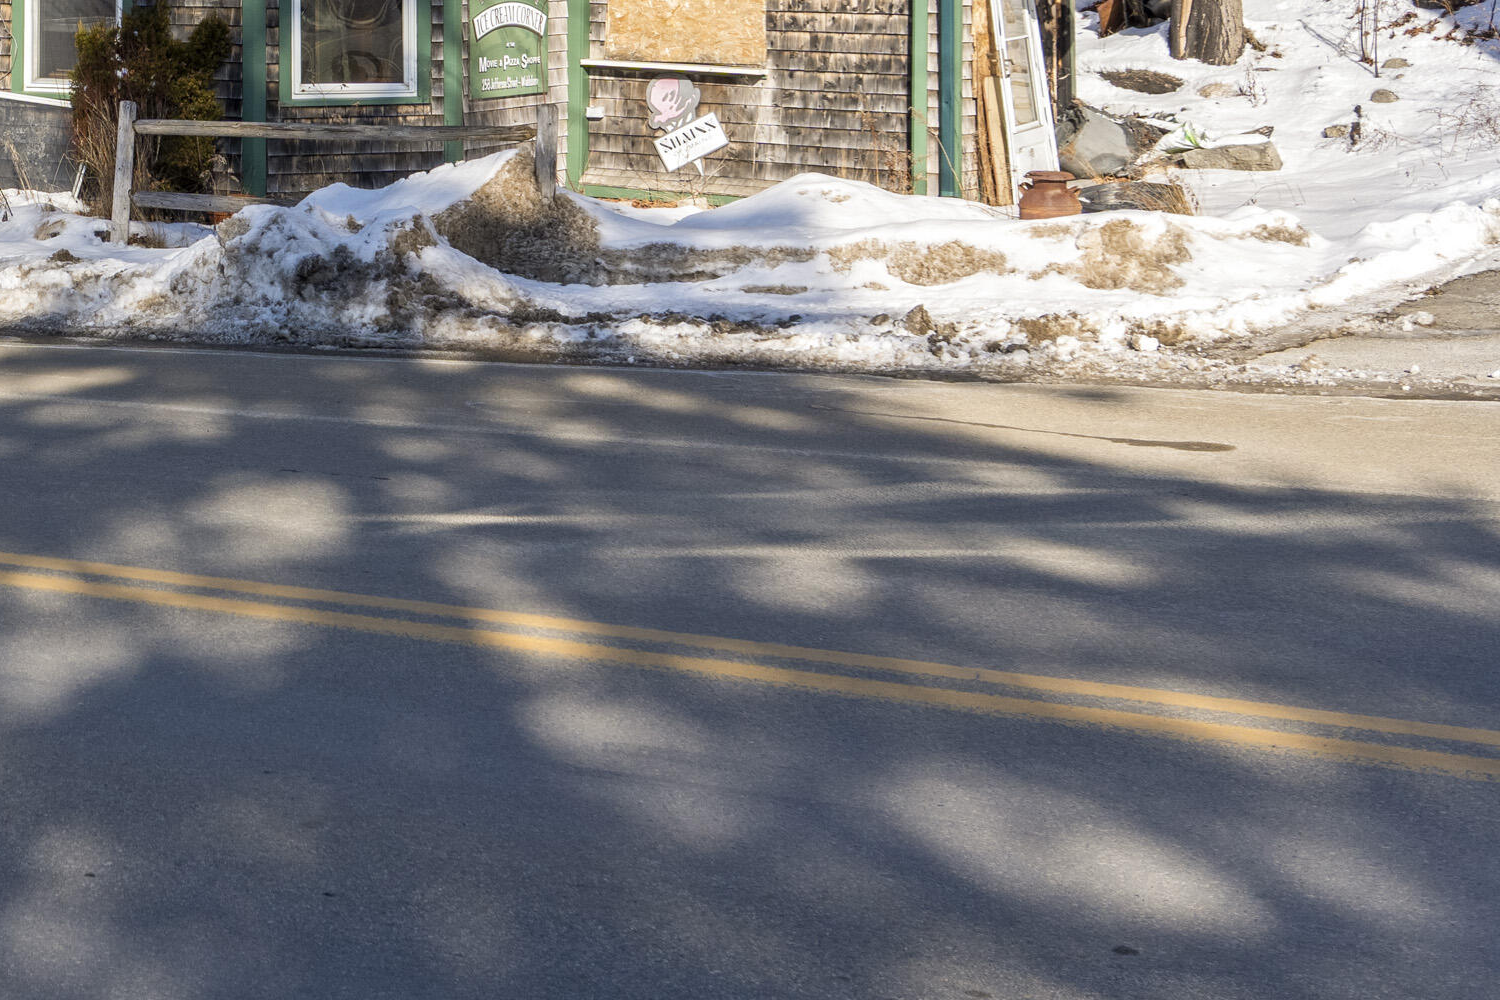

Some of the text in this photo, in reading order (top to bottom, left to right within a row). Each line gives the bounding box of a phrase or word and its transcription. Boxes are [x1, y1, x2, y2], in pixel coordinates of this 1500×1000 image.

[476, 5, 544, 37] ICE CREAM CORNER
